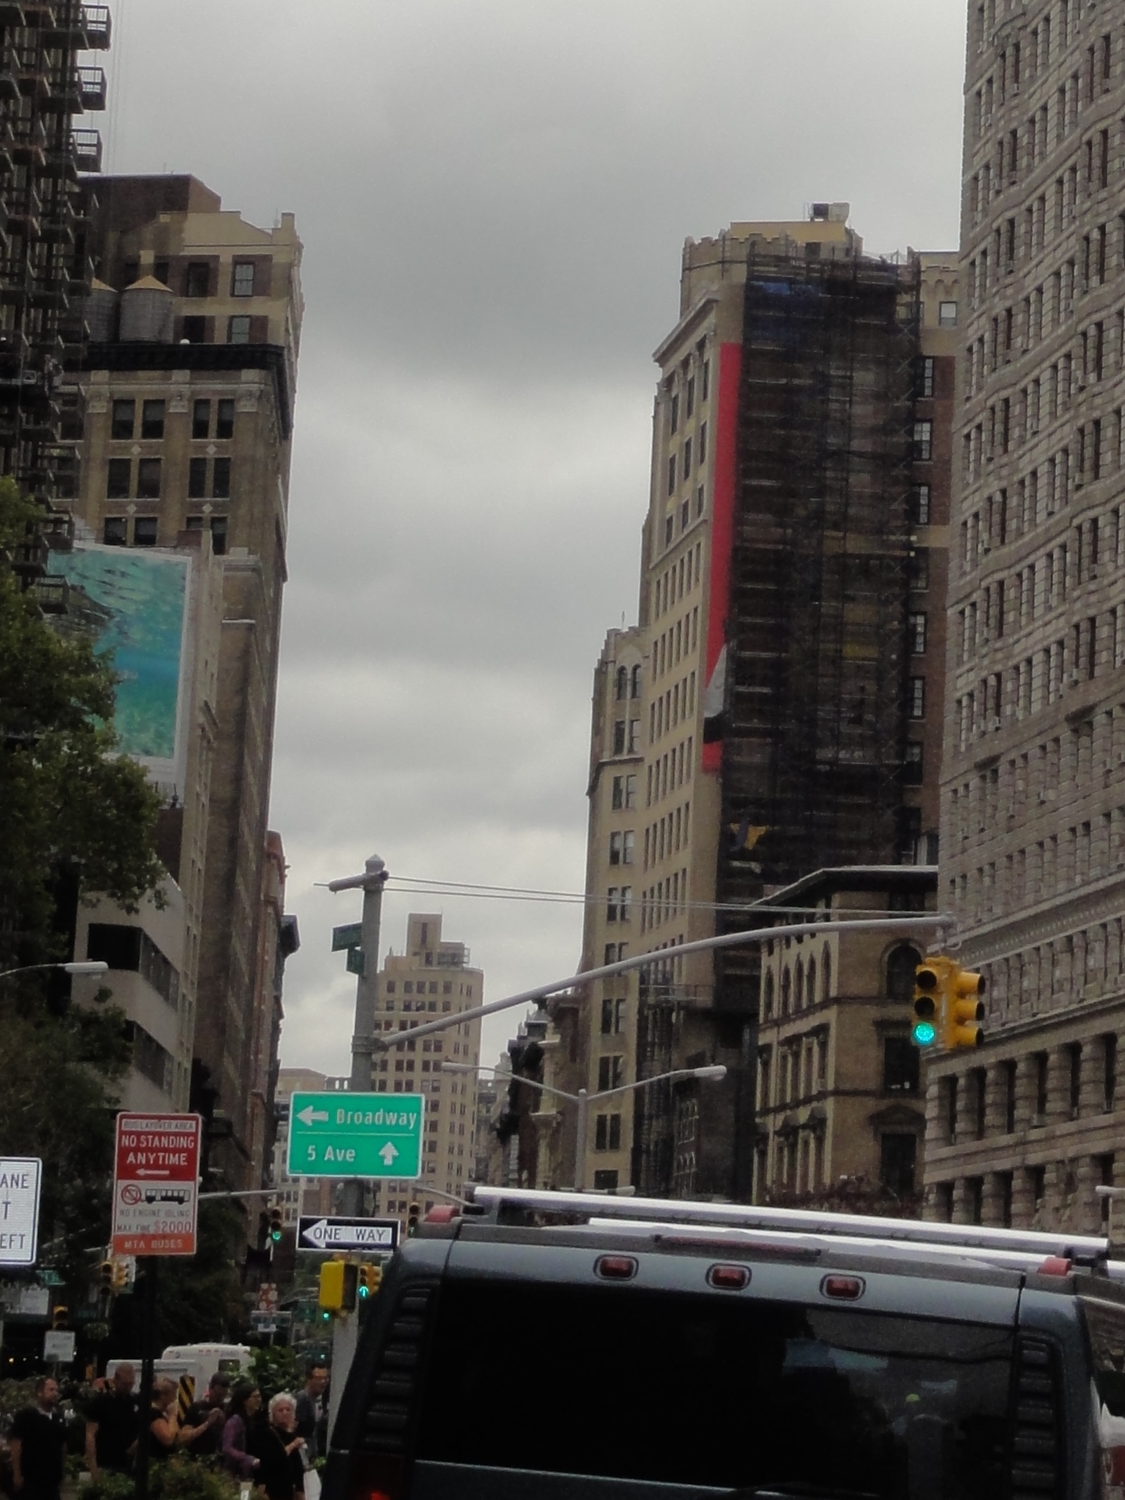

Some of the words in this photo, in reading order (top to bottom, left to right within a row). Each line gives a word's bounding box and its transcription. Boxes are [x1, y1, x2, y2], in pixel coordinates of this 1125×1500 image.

[336, 1108, 417, 1130] Broadway
[121, 1134, 137, 1147] NO
[139, 1135, 195, 1149] STANDING
[126, 1152, 188, 1165] ANYTIME
[307, 1145, 316, 1161] 5
[324, 1145, 356, 1162] Ave
[0, 1173, 29, 1189] ANE
[154, 1220, 192, 1233] $2000
[0, 1234, 26, 1249] EFT
[313, 1228, 342, 1241] ONE
[355, 1228, 387, 1241] WAY
[124, 1240, 146, 1249] MTA
[151, 1239, 183, 1249] BUSES
